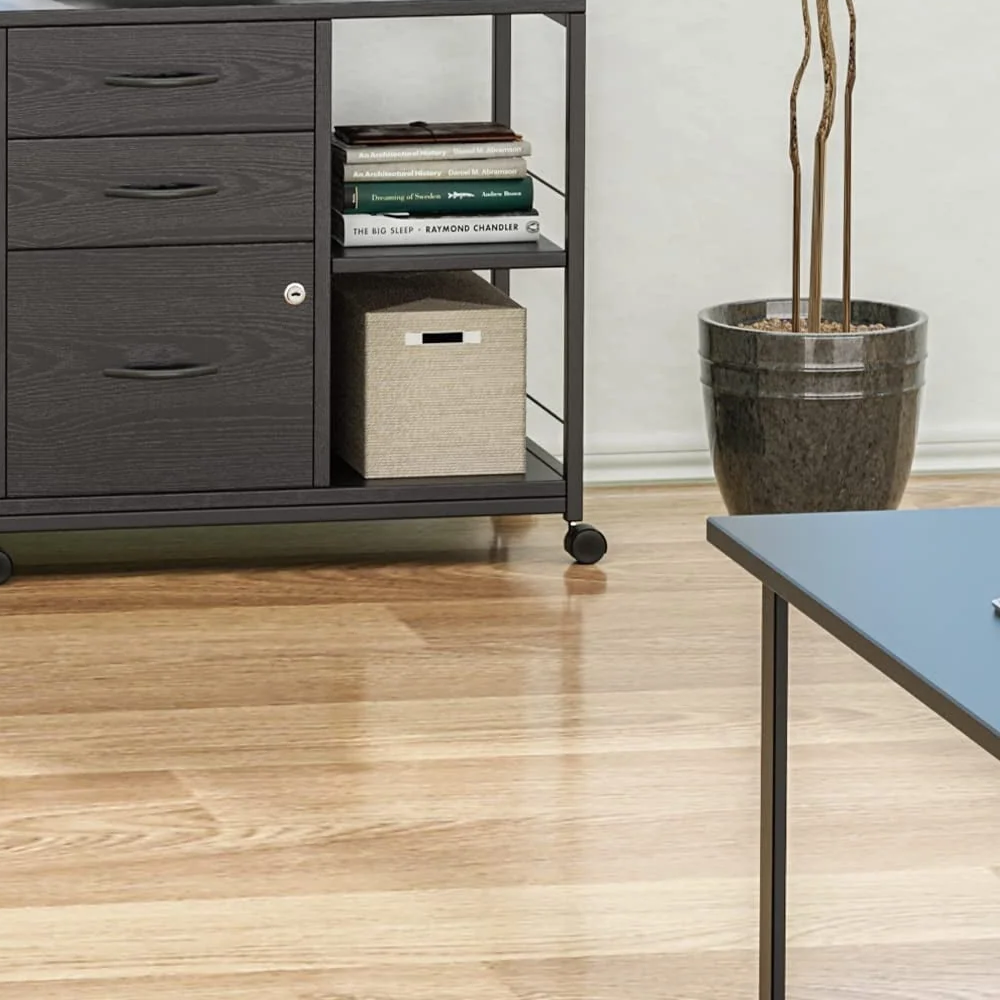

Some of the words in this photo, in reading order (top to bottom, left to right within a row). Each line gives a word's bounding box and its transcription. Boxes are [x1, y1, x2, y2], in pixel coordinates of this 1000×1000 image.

[371, 193, 405, 203] Dreaming
[405, 192, 414, 201] of
[414, 192, 442, 201] Sweden
[481, 190, 503, 198] Andrew
[352, 227, 369, 236] THE
[371, 226, 387, 236] BIG
[390, 225, 415, 235] SLEEP
[425, 224, 471, 234] RAYMOND
[473, 222, 520, 233] CHANDLER
